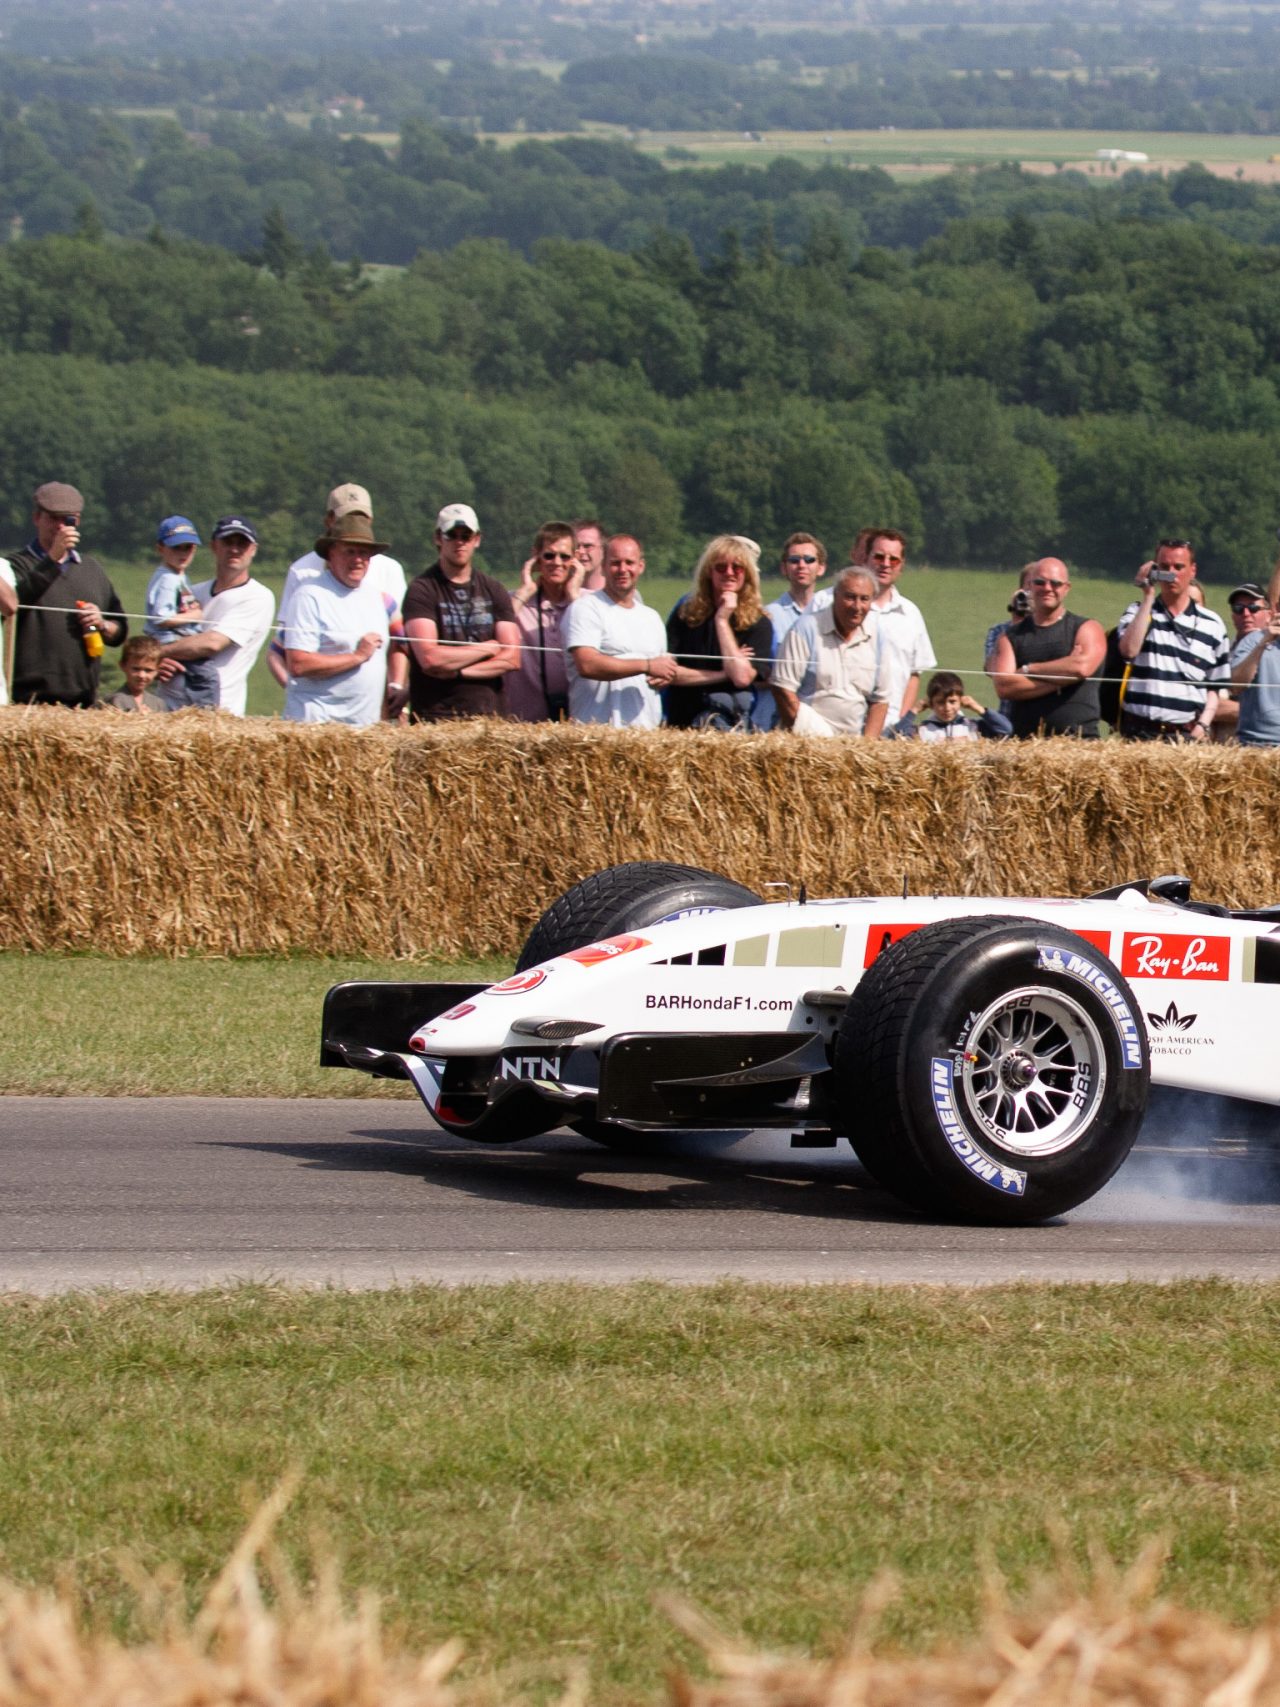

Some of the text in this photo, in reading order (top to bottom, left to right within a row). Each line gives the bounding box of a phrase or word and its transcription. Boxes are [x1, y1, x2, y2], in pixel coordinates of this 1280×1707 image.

[646, 995, 793, 1010] BARHondaF1.com
[1065, 956, 1141, 1064] MICHELIN
[502, 1057, 561, 1080] NTN
[1072, 1061, 1092, 1112] BBS
[934, 1062, 1000, 1182] MICHELIN
